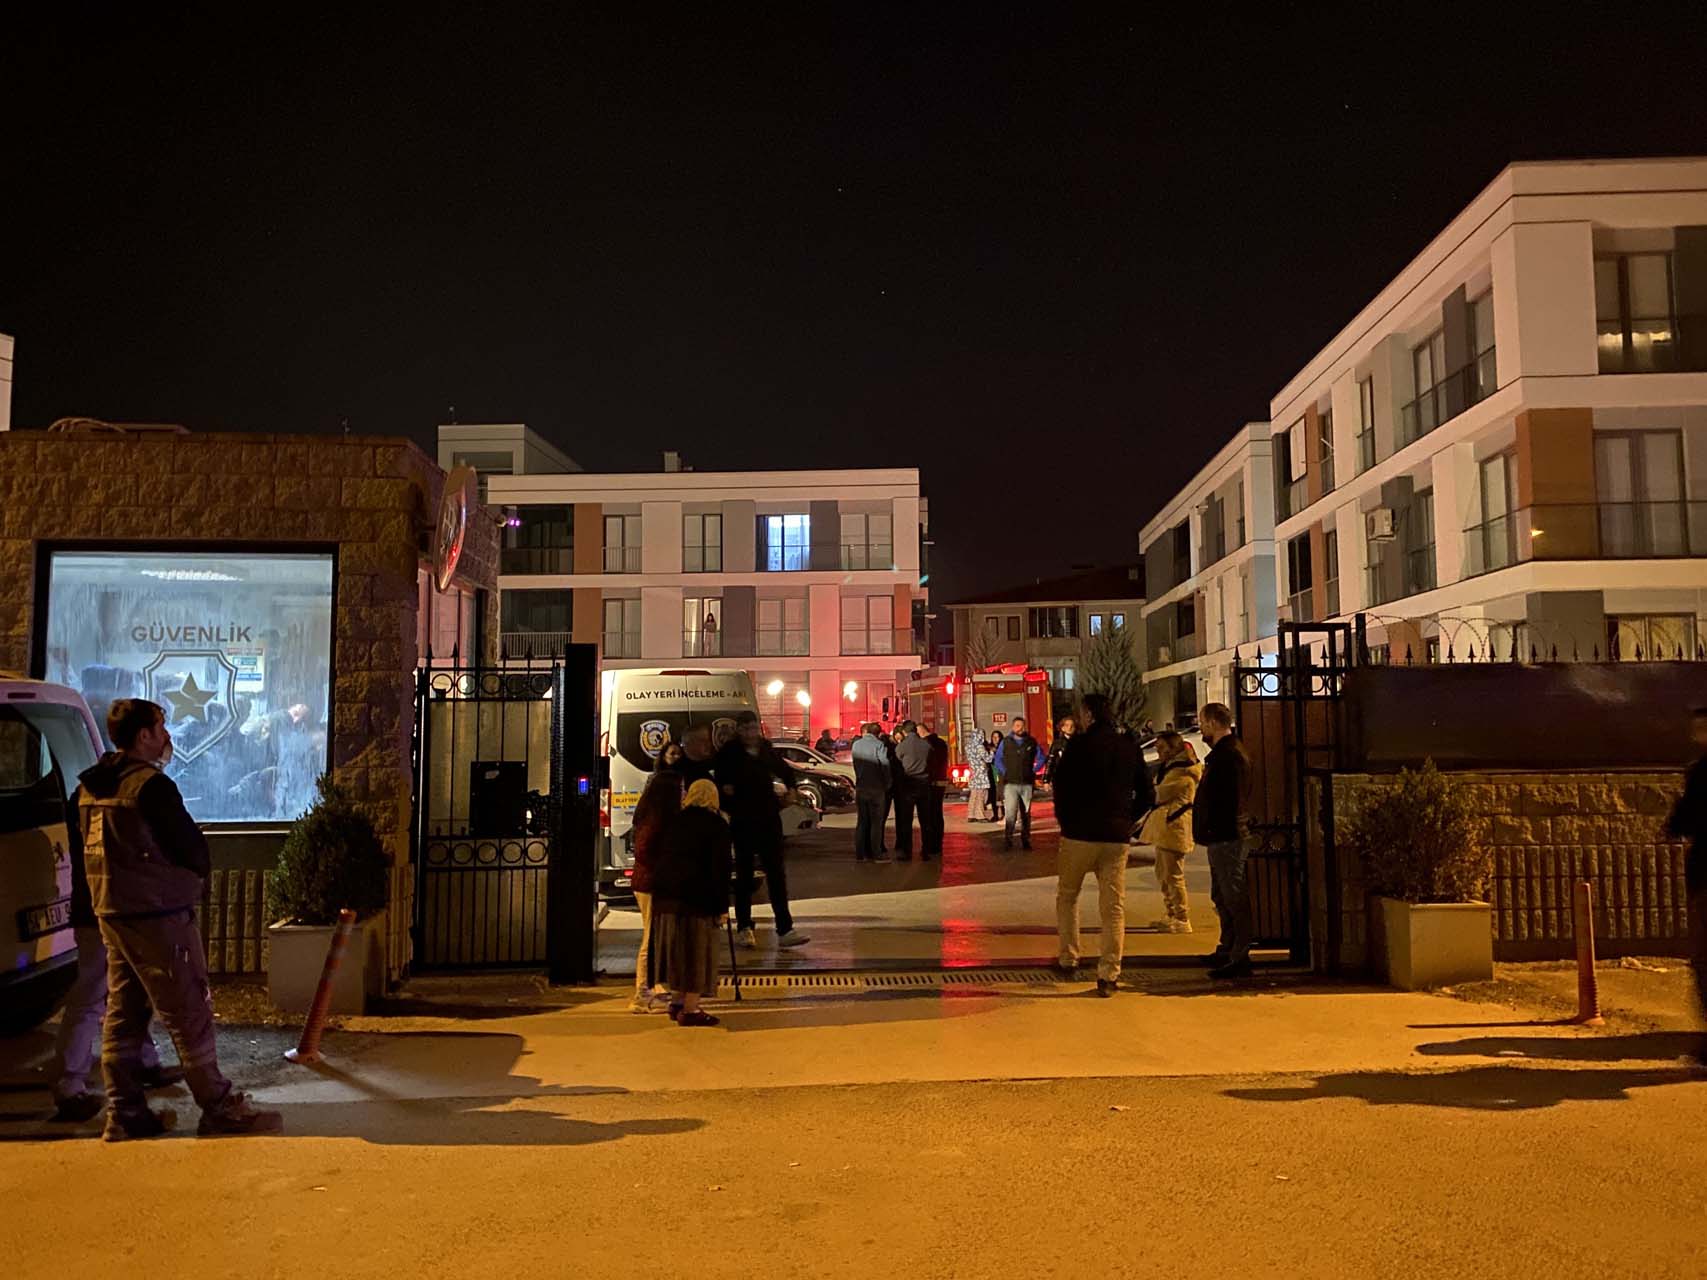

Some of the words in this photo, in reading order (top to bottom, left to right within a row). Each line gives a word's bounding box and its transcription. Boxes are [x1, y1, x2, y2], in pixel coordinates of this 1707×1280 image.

[131, 621, 251, 643] GÜVENLİK
[626, 691, 652, 700] OLAY
[653, 689, 676, 699] YERİ
[677, 688, 725, 698] İNCELEME
